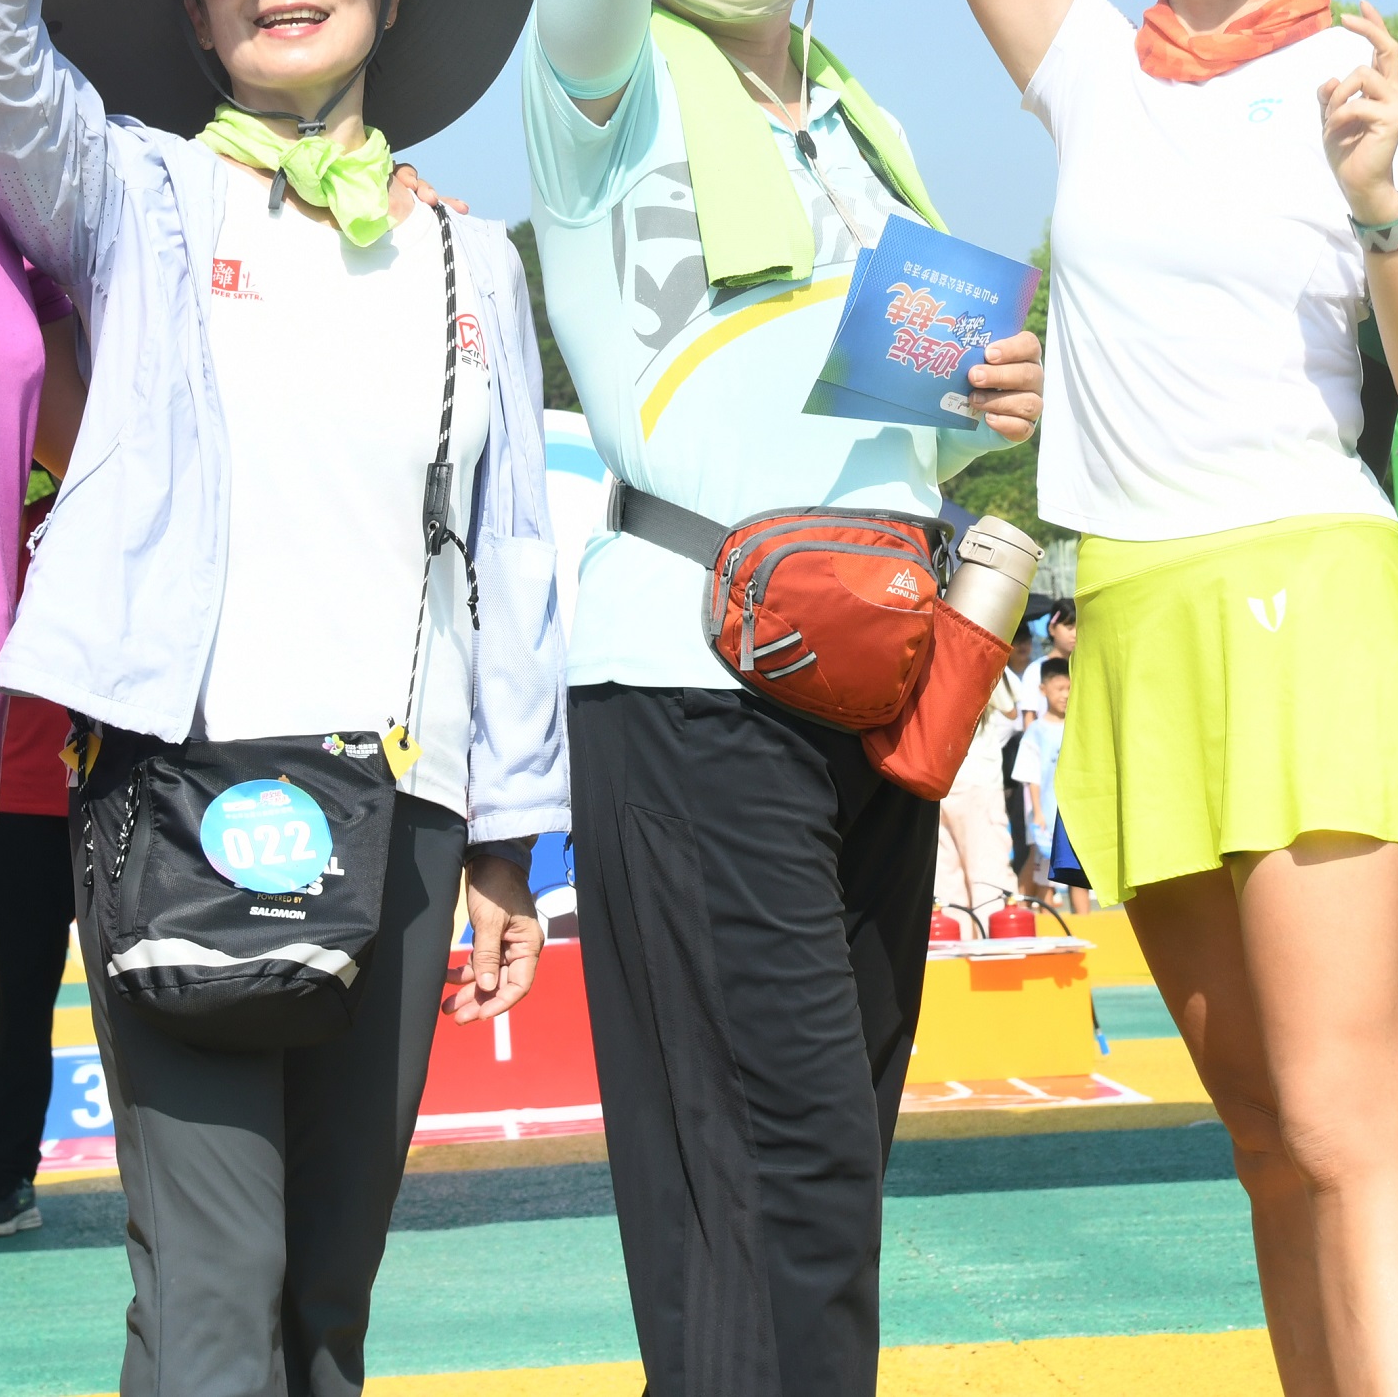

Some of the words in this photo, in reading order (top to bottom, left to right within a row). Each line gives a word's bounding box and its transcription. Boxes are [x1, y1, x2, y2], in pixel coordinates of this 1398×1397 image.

[885, 281, 957, 333] 一起走
[903, 259, 1000, 306] 中山市全民公益健步活动
[886, 328, 971, 380] 迎全运
[221, 820, 318, 870] 022
[249, 906, 307, 920] SALOMON
[256, 892, 292, 904] POWERED
[293, 895, 304, 904] BY
[69, 1063, 115, 1129] 3
